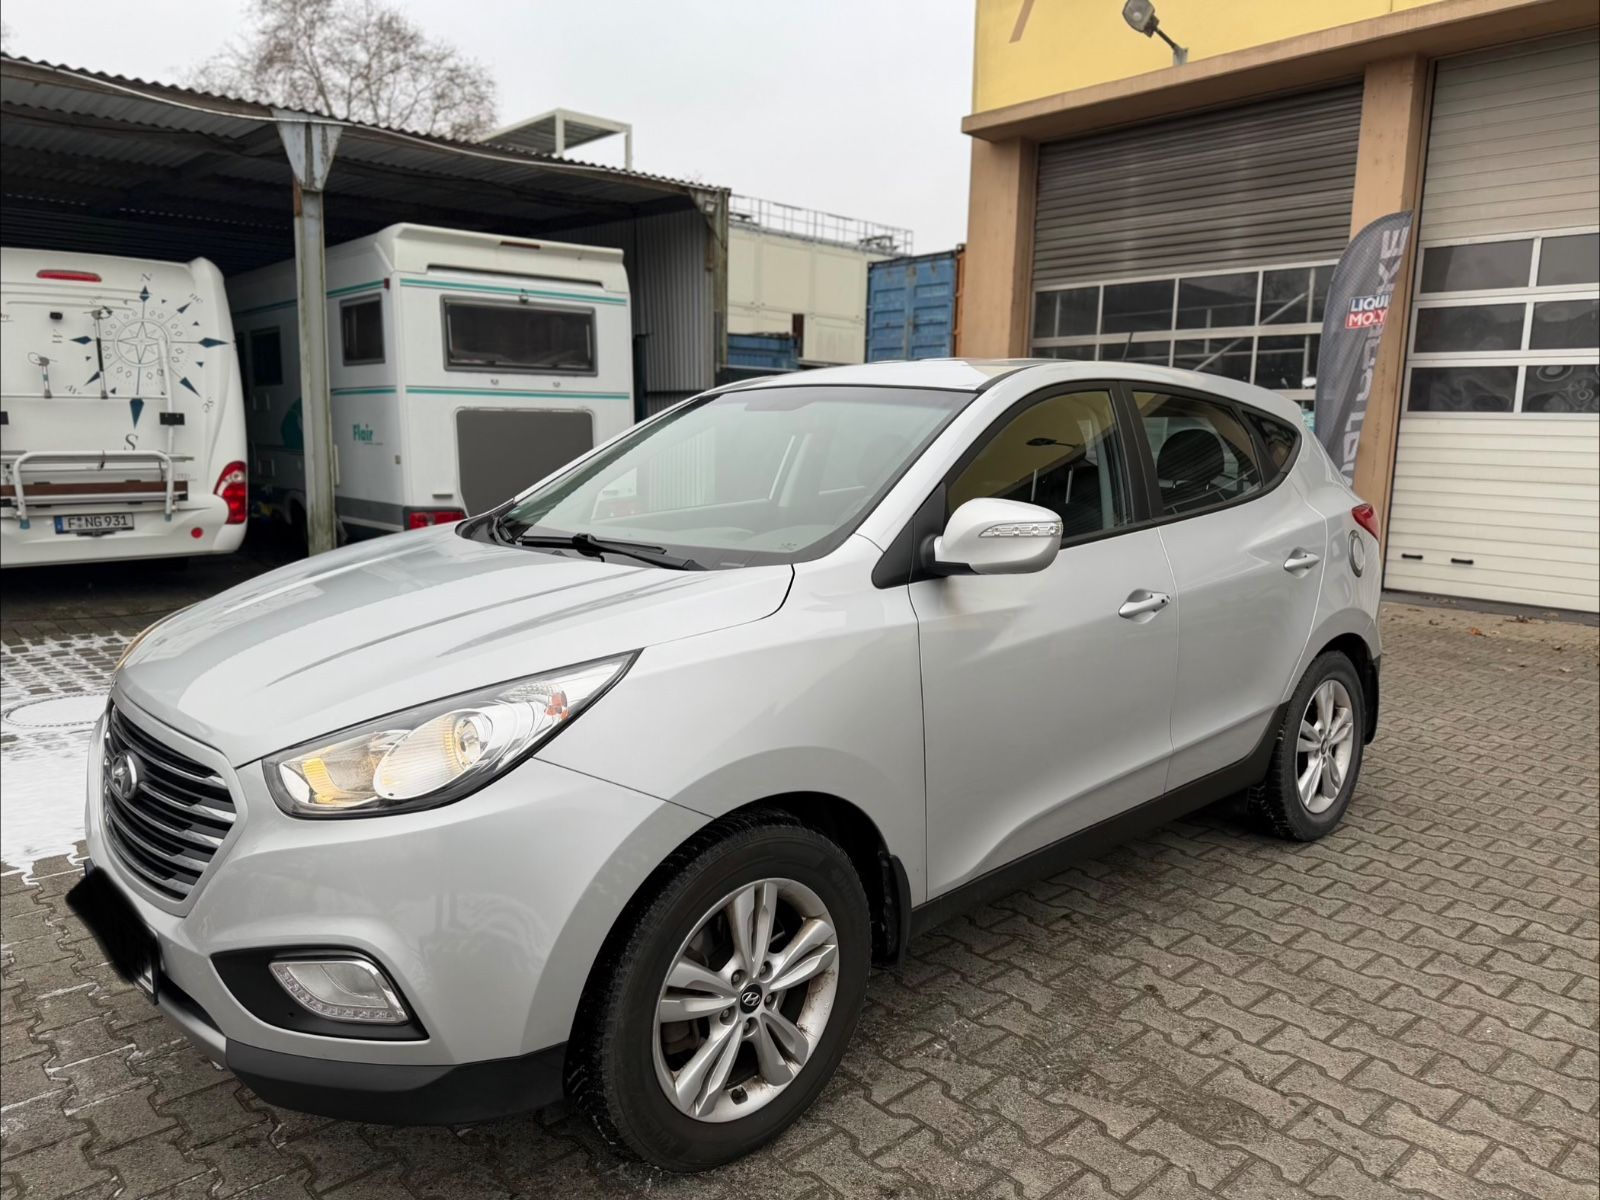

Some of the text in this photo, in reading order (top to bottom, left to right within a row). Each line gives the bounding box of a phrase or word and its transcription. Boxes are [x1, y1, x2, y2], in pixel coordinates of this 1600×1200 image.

[1350, 295, 1389, 312] LIQUI
[1348, 310, 1386, 327] MOLY
[353, 423, 374, 442] Flair
[67, 515, 128, 529] F NG 931
